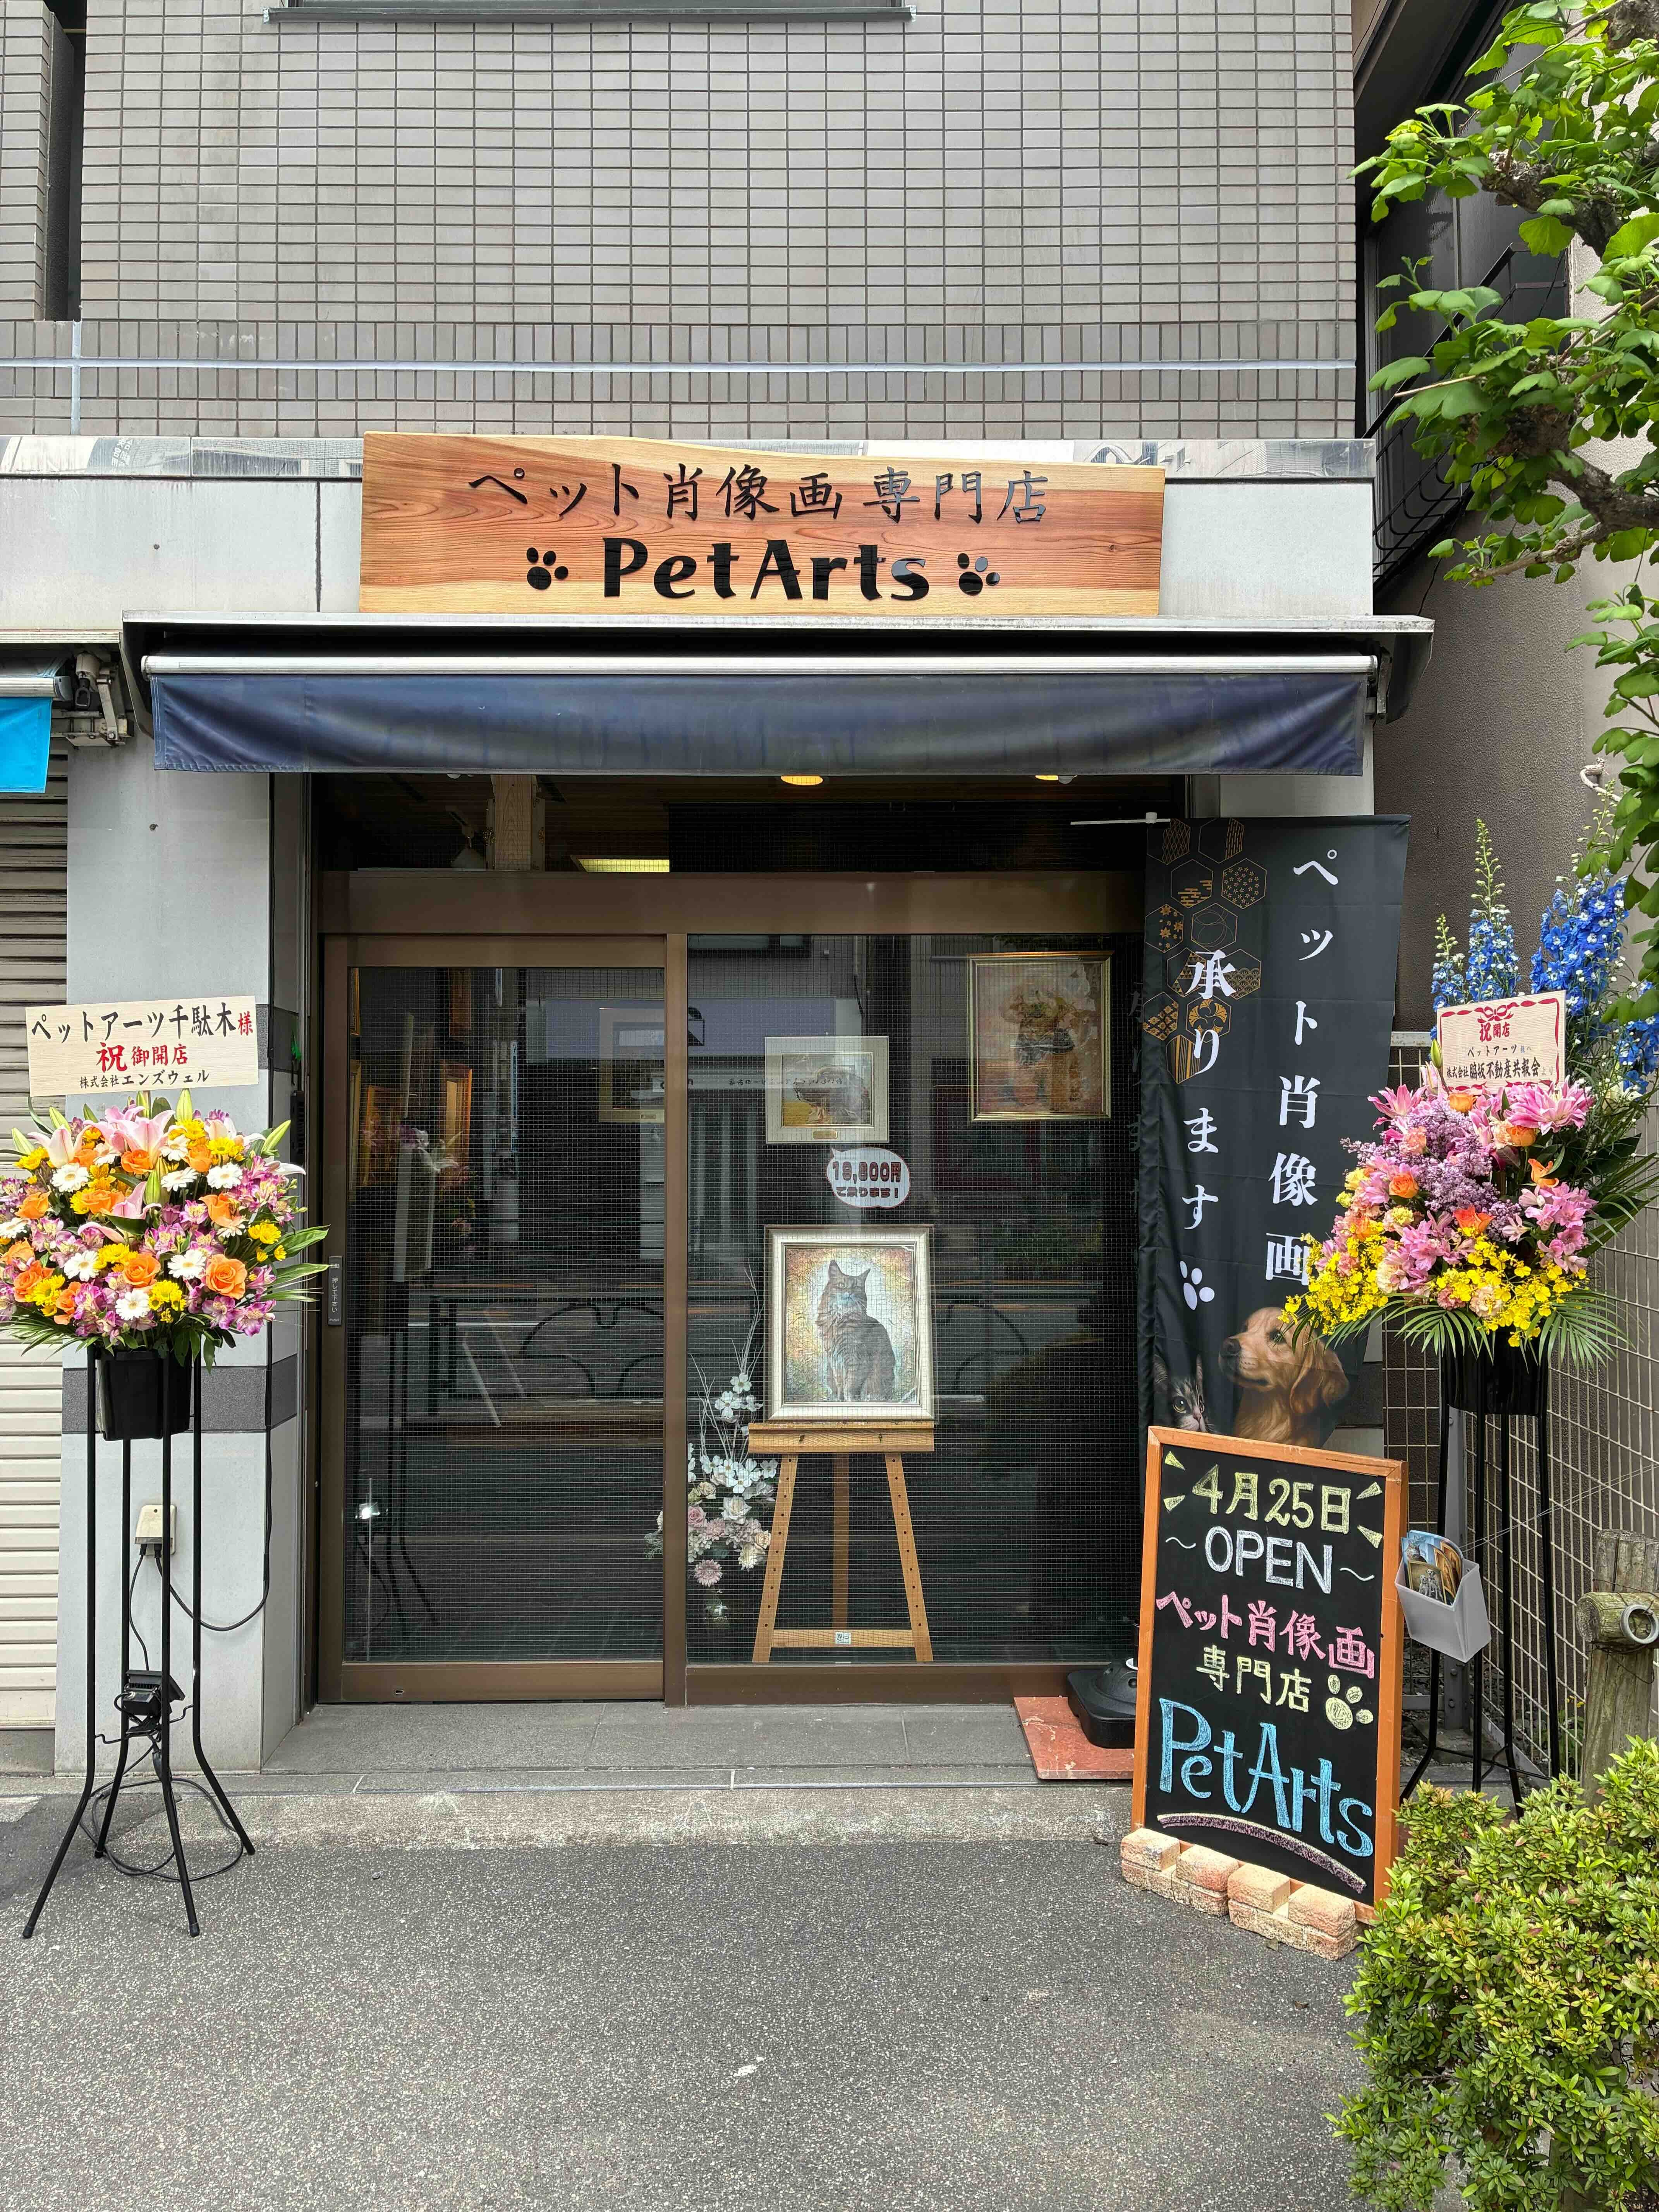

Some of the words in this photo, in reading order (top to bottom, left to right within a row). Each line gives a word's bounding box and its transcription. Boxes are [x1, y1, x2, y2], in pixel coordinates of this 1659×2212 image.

[469, 463, 1049, 525] ペット肖像画専門店
[602, 537, 930, 602] PetArts
[31, 1002, 254, 1043] ペットアーツ千駄木様
[79, 1069, 210, 1089] 株式会社エンズウェル
[1182, 950, 1237, 1230] 承ります
[1265, 849, 1339, 1286] ペット肖像画
[1192, 1463, 1352, 1534] 4月25日
[1156, 1590, 1375, 1679] ペット肖像画
[1196, 1644, 1312, 1714] 専門店
[1159, 1698, 1374, 1858] PetArts
